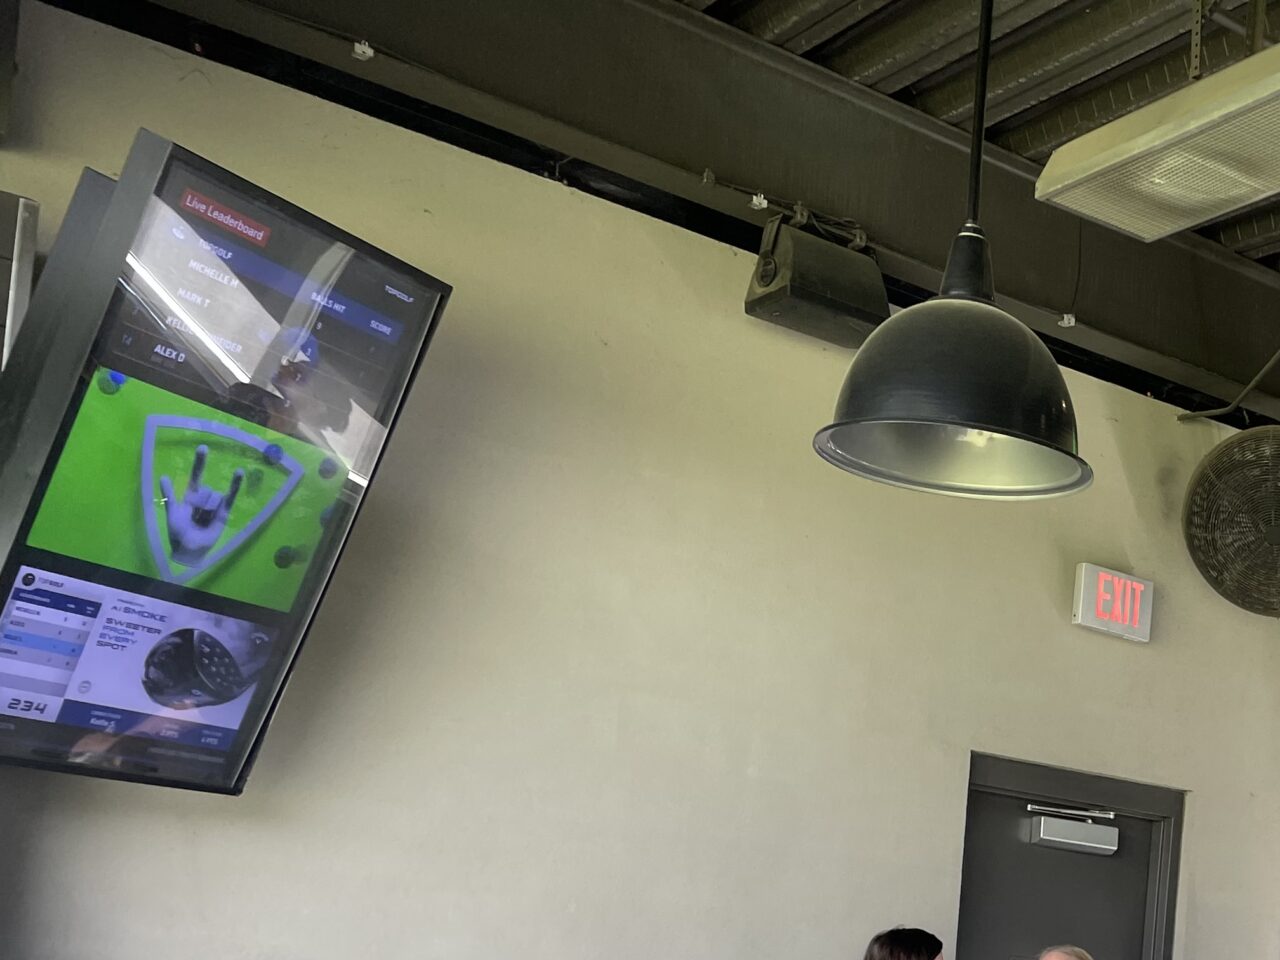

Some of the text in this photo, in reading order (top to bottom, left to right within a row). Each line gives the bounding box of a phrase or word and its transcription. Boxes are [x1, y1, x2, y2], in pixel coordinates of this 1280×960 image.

[185, 194, 265, 241] Live Leaderboard
[188, 258, 230, 285] MICHELLE
[333, 302, 346, 313] HIT
[369, 320, 393, 336] SCORE
[153, 344, 186, 363] ALEX D
[1095, 571, 1145, 628] EXIT
[122, 606, 168, 622] SMOKE
[102, 625, 135, 636] FROM
[105, 617, 162, 635] SWEETER
[96, 640, 127, 651] SPOT
[99, 632, 137, 645] EVERY
[7, 698, 48, 714] 234
